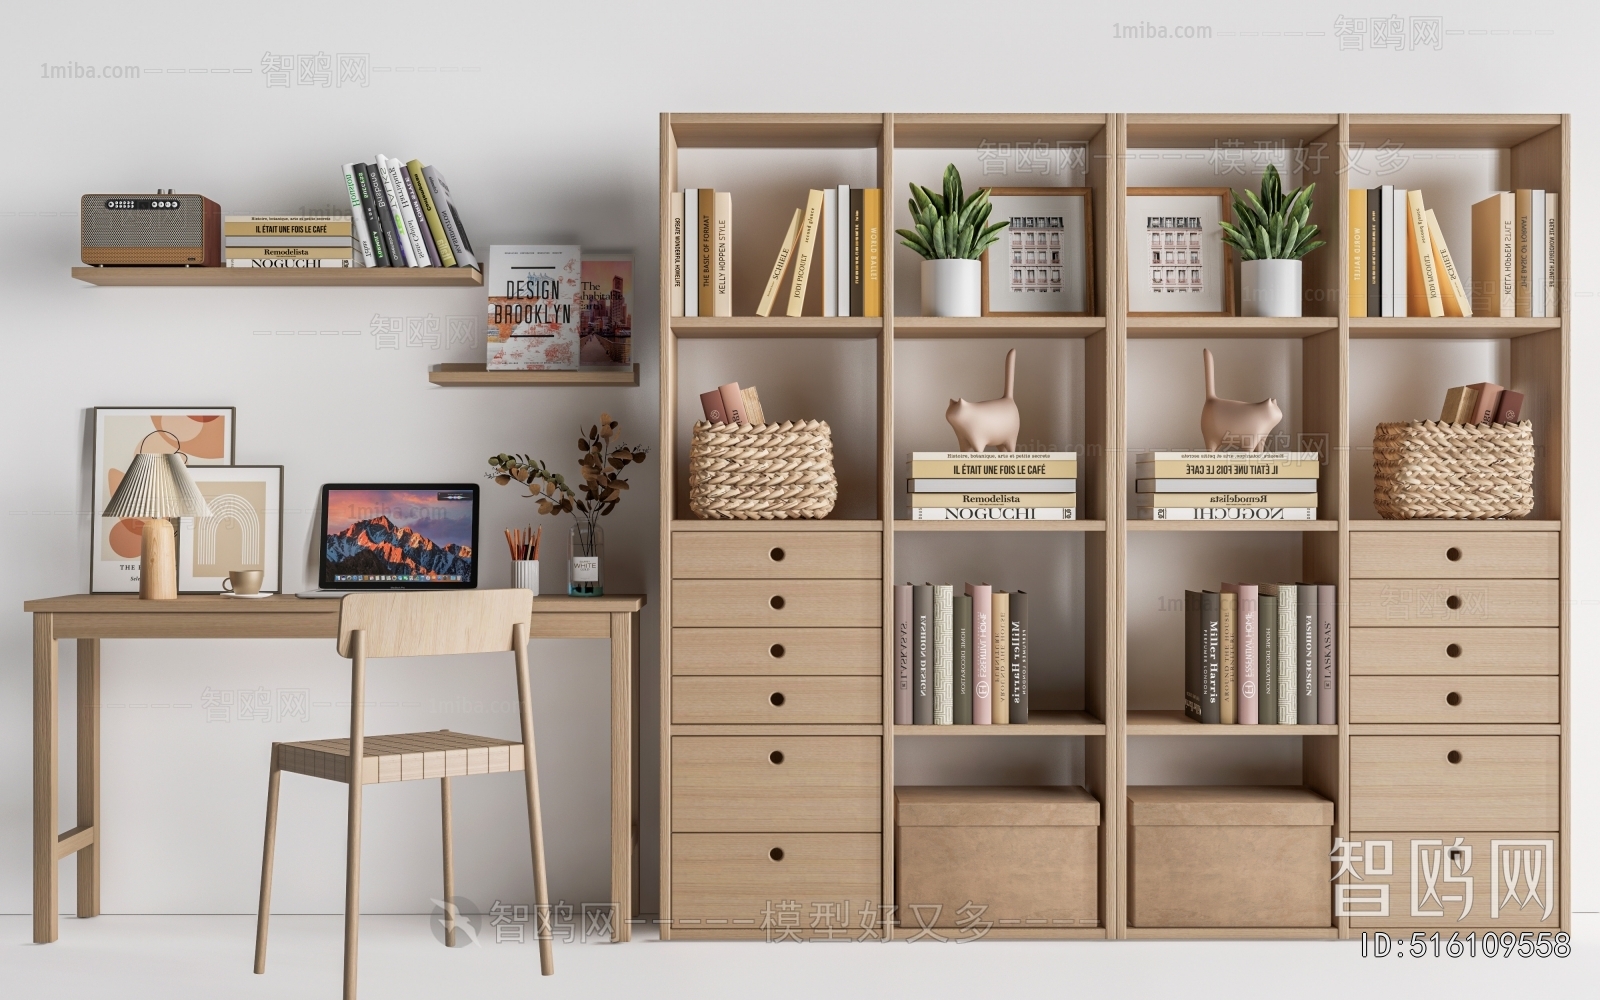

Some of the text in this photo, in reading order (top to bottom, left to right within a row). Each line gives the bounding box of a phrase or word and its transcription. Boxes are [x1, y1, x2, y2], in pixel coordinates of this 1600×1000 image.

[255, 224, 327, 233] IL ÉTAIT UNE FOIS LE CAFÉ
[703, 243, 710, 253] OF
[870, 227, 878, 281] WORLD BALLET
[251, 259, 321, 268] NOGUCHI
[718, 219, 726, 295] KELLY HOPPEN STYLE
[772, 248, 790, 280] SCHIELE
[793, 253, 808, 299] JODI PICOULT
[507, 280, 560, 300] DESIGN
[580, 281, 601, 291] The
[494, 304, 571, 324] BROOKLYN
[953, 463, 1046, 475] IL ÉTAIT UNE FOIS LE CAFÉ
[962, 494, 1021, 503] Remodelista
[944, 508, 1036, 520] NOGUCHI
[1209, 620, 1218, 704] Miller Harris
